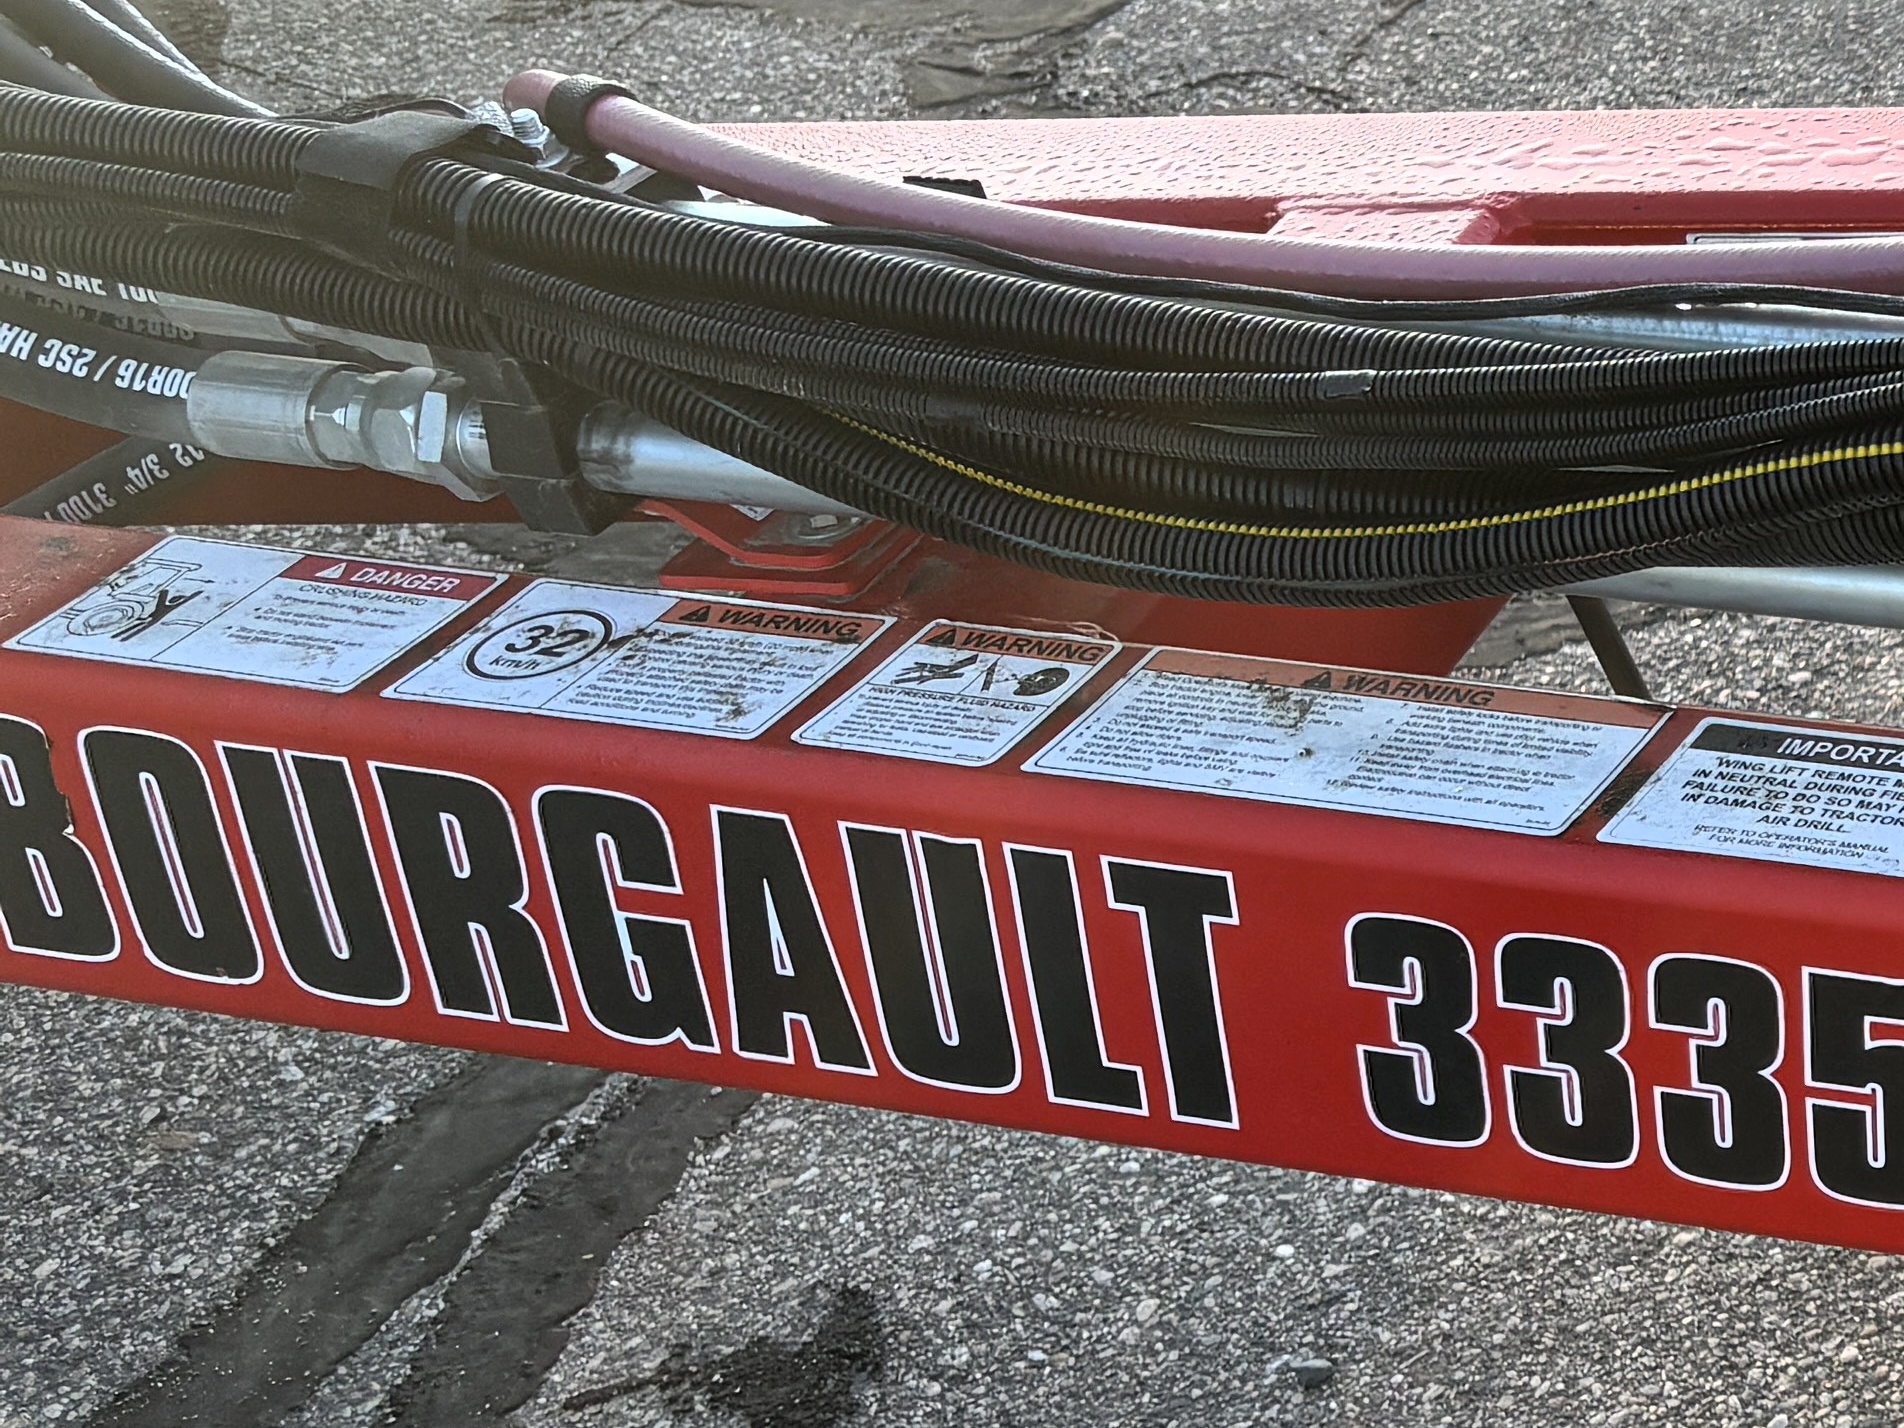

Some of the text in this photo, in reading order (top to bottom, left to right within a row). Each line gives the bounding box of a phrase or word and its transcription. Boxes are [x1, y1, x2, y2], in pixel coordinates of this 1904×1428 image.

[37, 338, 97, 378] 2SC
[124, 453, 170, 495] 3/4"
[350, 567, 461, 592] DANGER
[716, 610, 863, 638] WARNING
[503, 623, 590, 658] 32
[960, 632, 1106, 664] WARNING
[488, 655, 541, 672] km/h
[1341, 674, 1496, 706] WARNING
[1690, 768, 1714, 778] IN
[1712, 771, 1802, 789] NEUTRAL
[1801, 781, 1878, 798] DURING
[1713, 757, 1768, 772] WING
[1766, 764, 1810, 777] LIFT
[1809, 769, 1891, 786] REMOTE
[1679, 792, 1704, 803] IN
[1701, 794, 1786, 812] DAMAGE
[1785, 804, 1816, 816] TO
[1680, 779, 1760, 797] FAILURE
[1762, 789, 1790, 800] TO
[1790, 792, 1823, 804] DO
[1822, 796, 1854, 808] SO
[1853, 800, 1897, 813] MAY
[1755, 813, 1856, 834] AIR DRILL.
[0, 714, 1240, 1130] BOURGAULT
